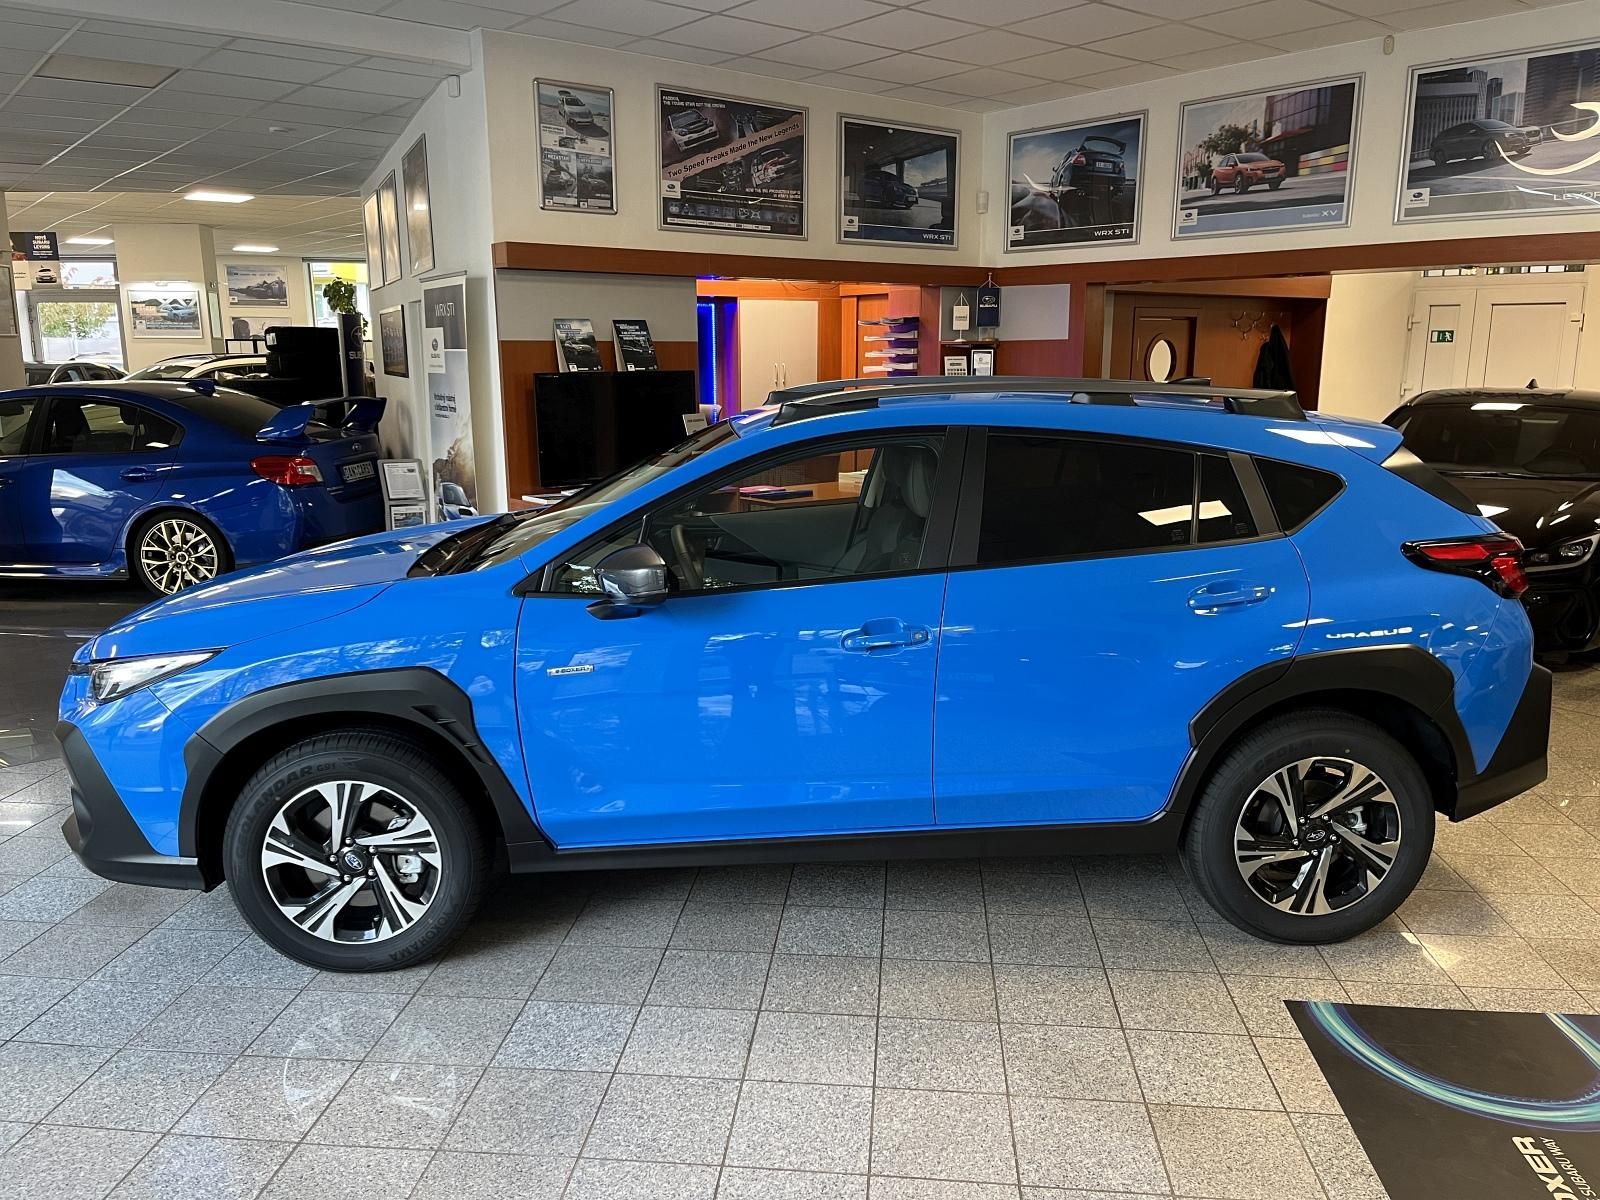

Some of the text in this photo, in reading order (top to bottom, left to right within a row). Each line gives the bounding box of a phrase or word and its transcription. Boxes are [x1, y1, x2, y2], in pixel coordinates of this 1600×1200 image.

[668, 122, 801, 178] Two Speed Freaks Made the New Legends
[1321, 208, 1338, 217] XV
[923, 233, 952, 241] WRX STI
[1094, 228, 1130, 237] WRX STI
[434, 302, 456, 317] WRX STI
[1539, 1136, 1565, 1157] WAY
